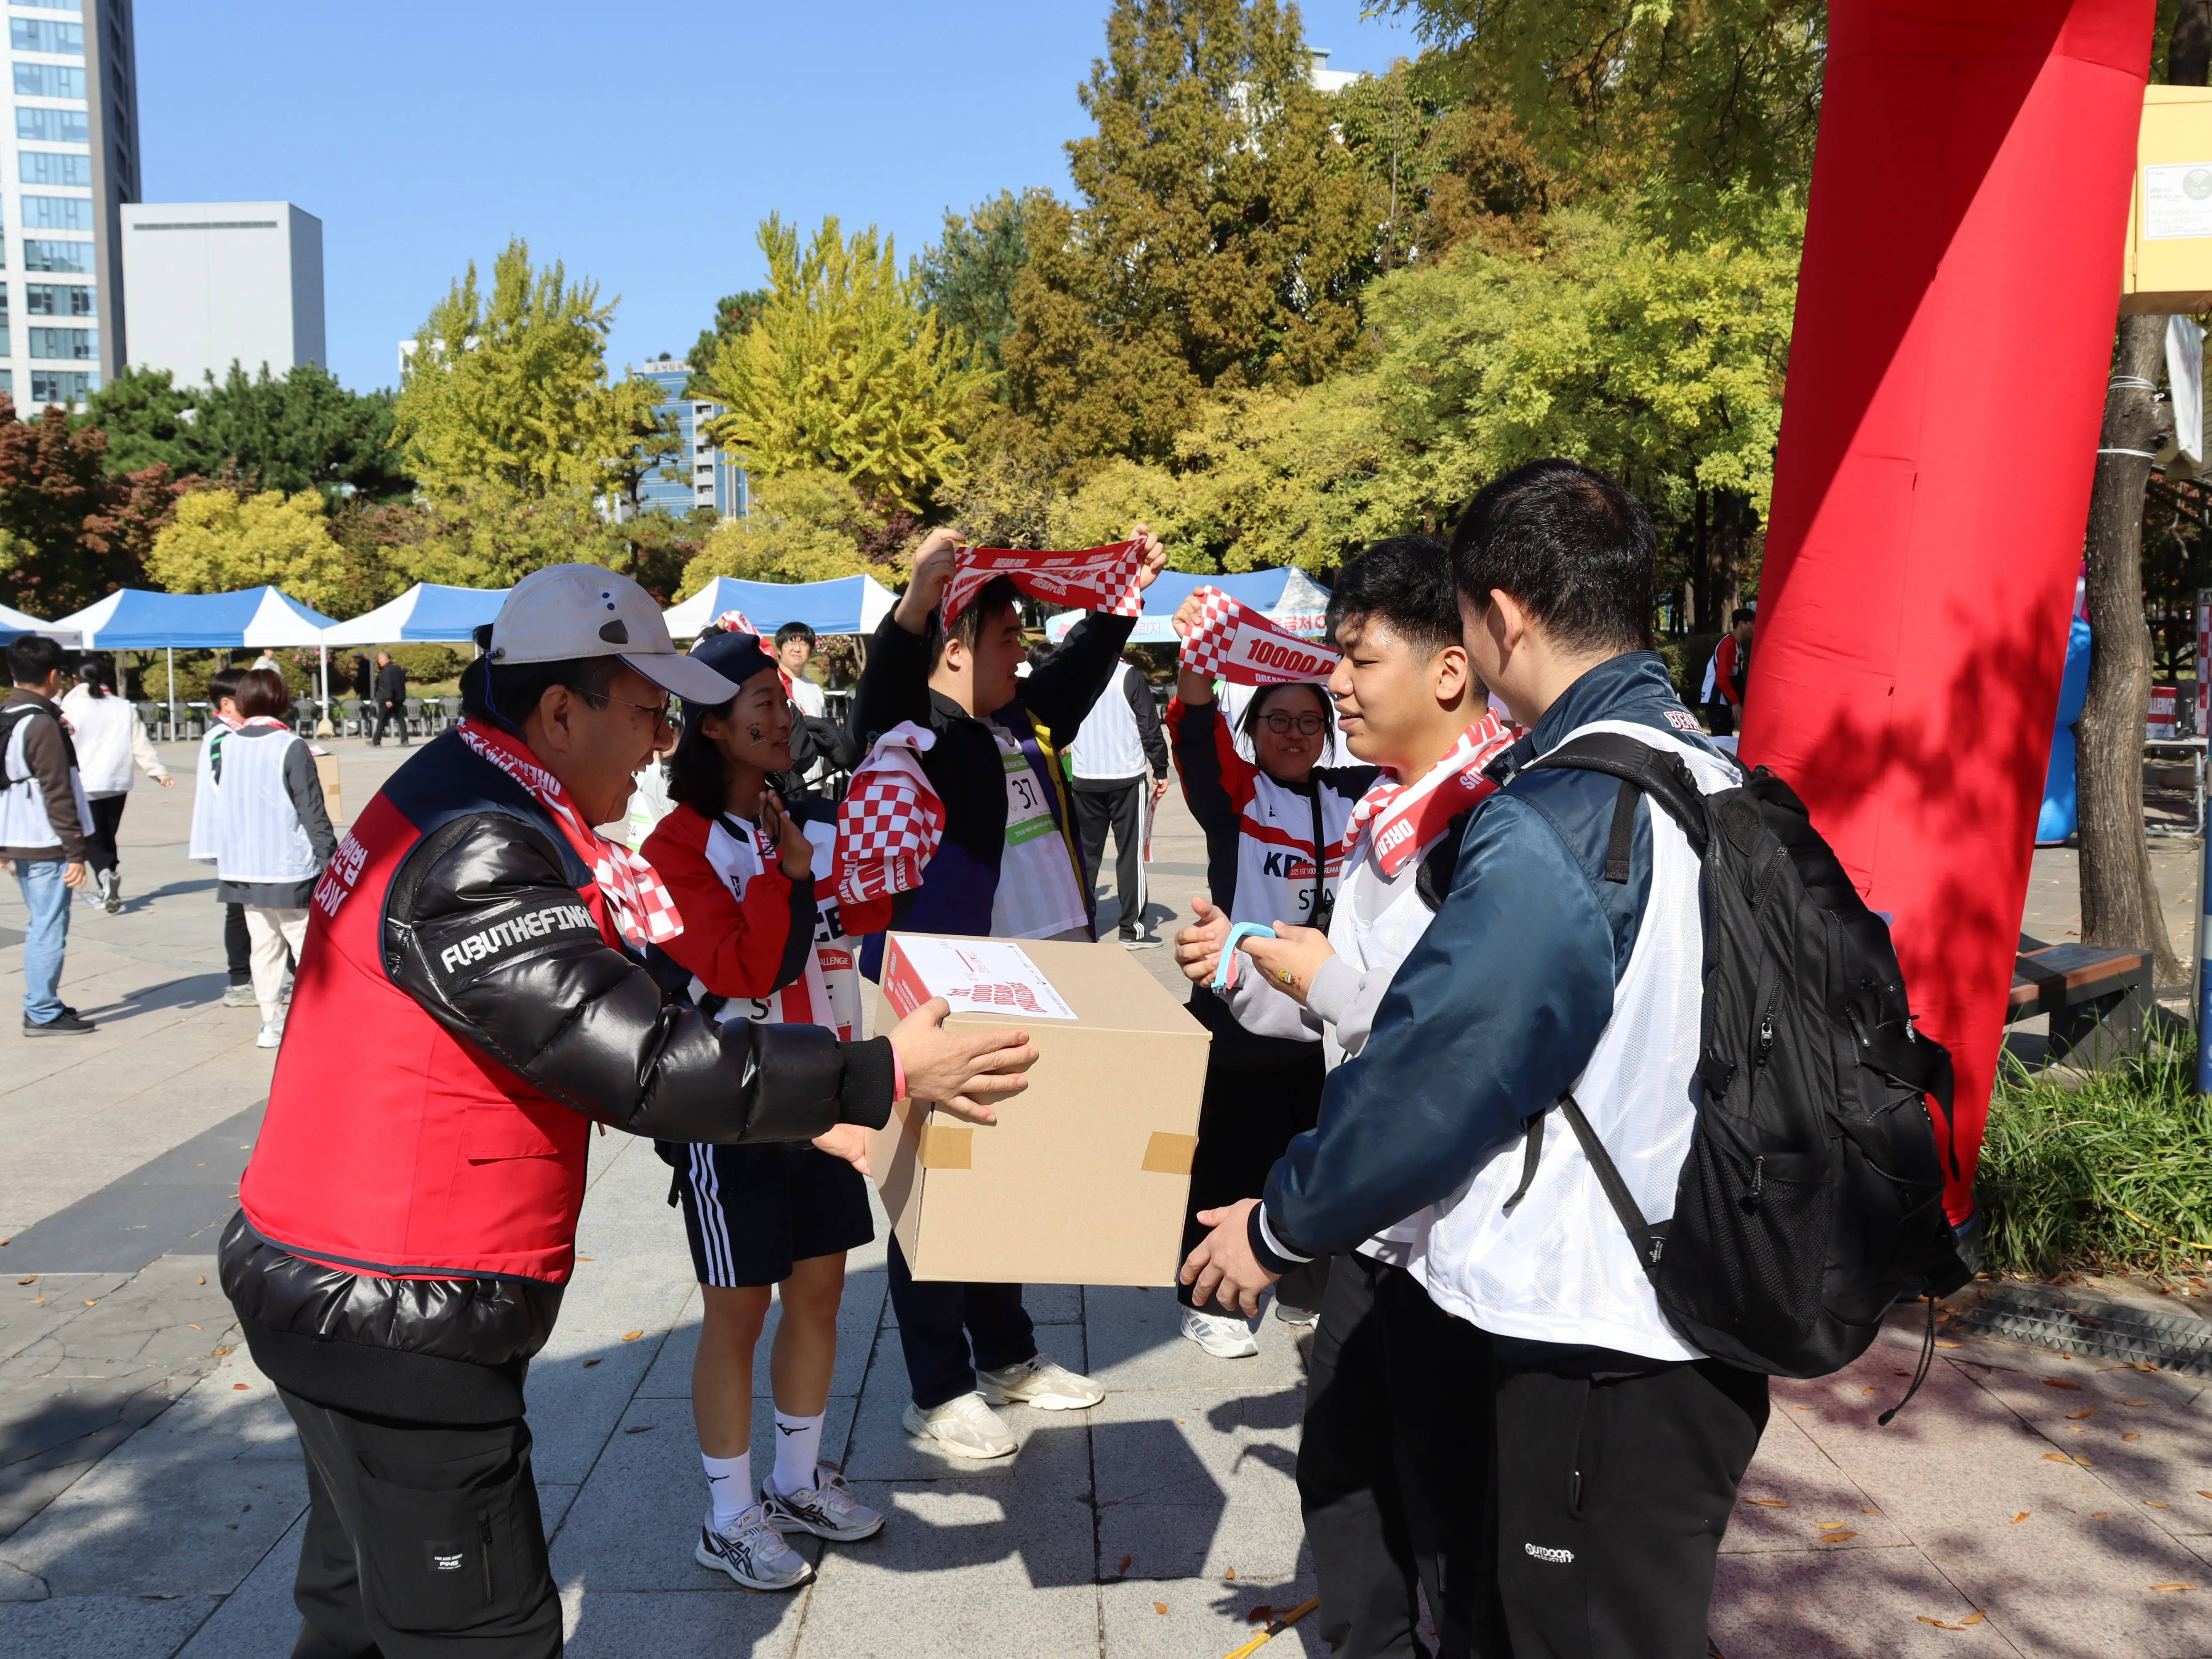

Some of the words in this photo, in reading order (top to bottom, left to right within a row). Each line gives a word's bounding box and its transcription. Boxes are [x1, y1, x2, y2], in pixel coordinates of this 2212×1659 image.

[1247, 638, 1317, 673] 10000
[1012, 778, 1038, 809] 37
[819, 957, 849, 966] ALLENGE
[946, 988, 971, 997] 1st
[971, 984, 992, 1002] 10000
[993, 984, 1016, 1005] DREAM
[1004, 981, 1048, 1013] CHALLENGE
[1525, 1543, 1572, 1563] OUTDOOR
